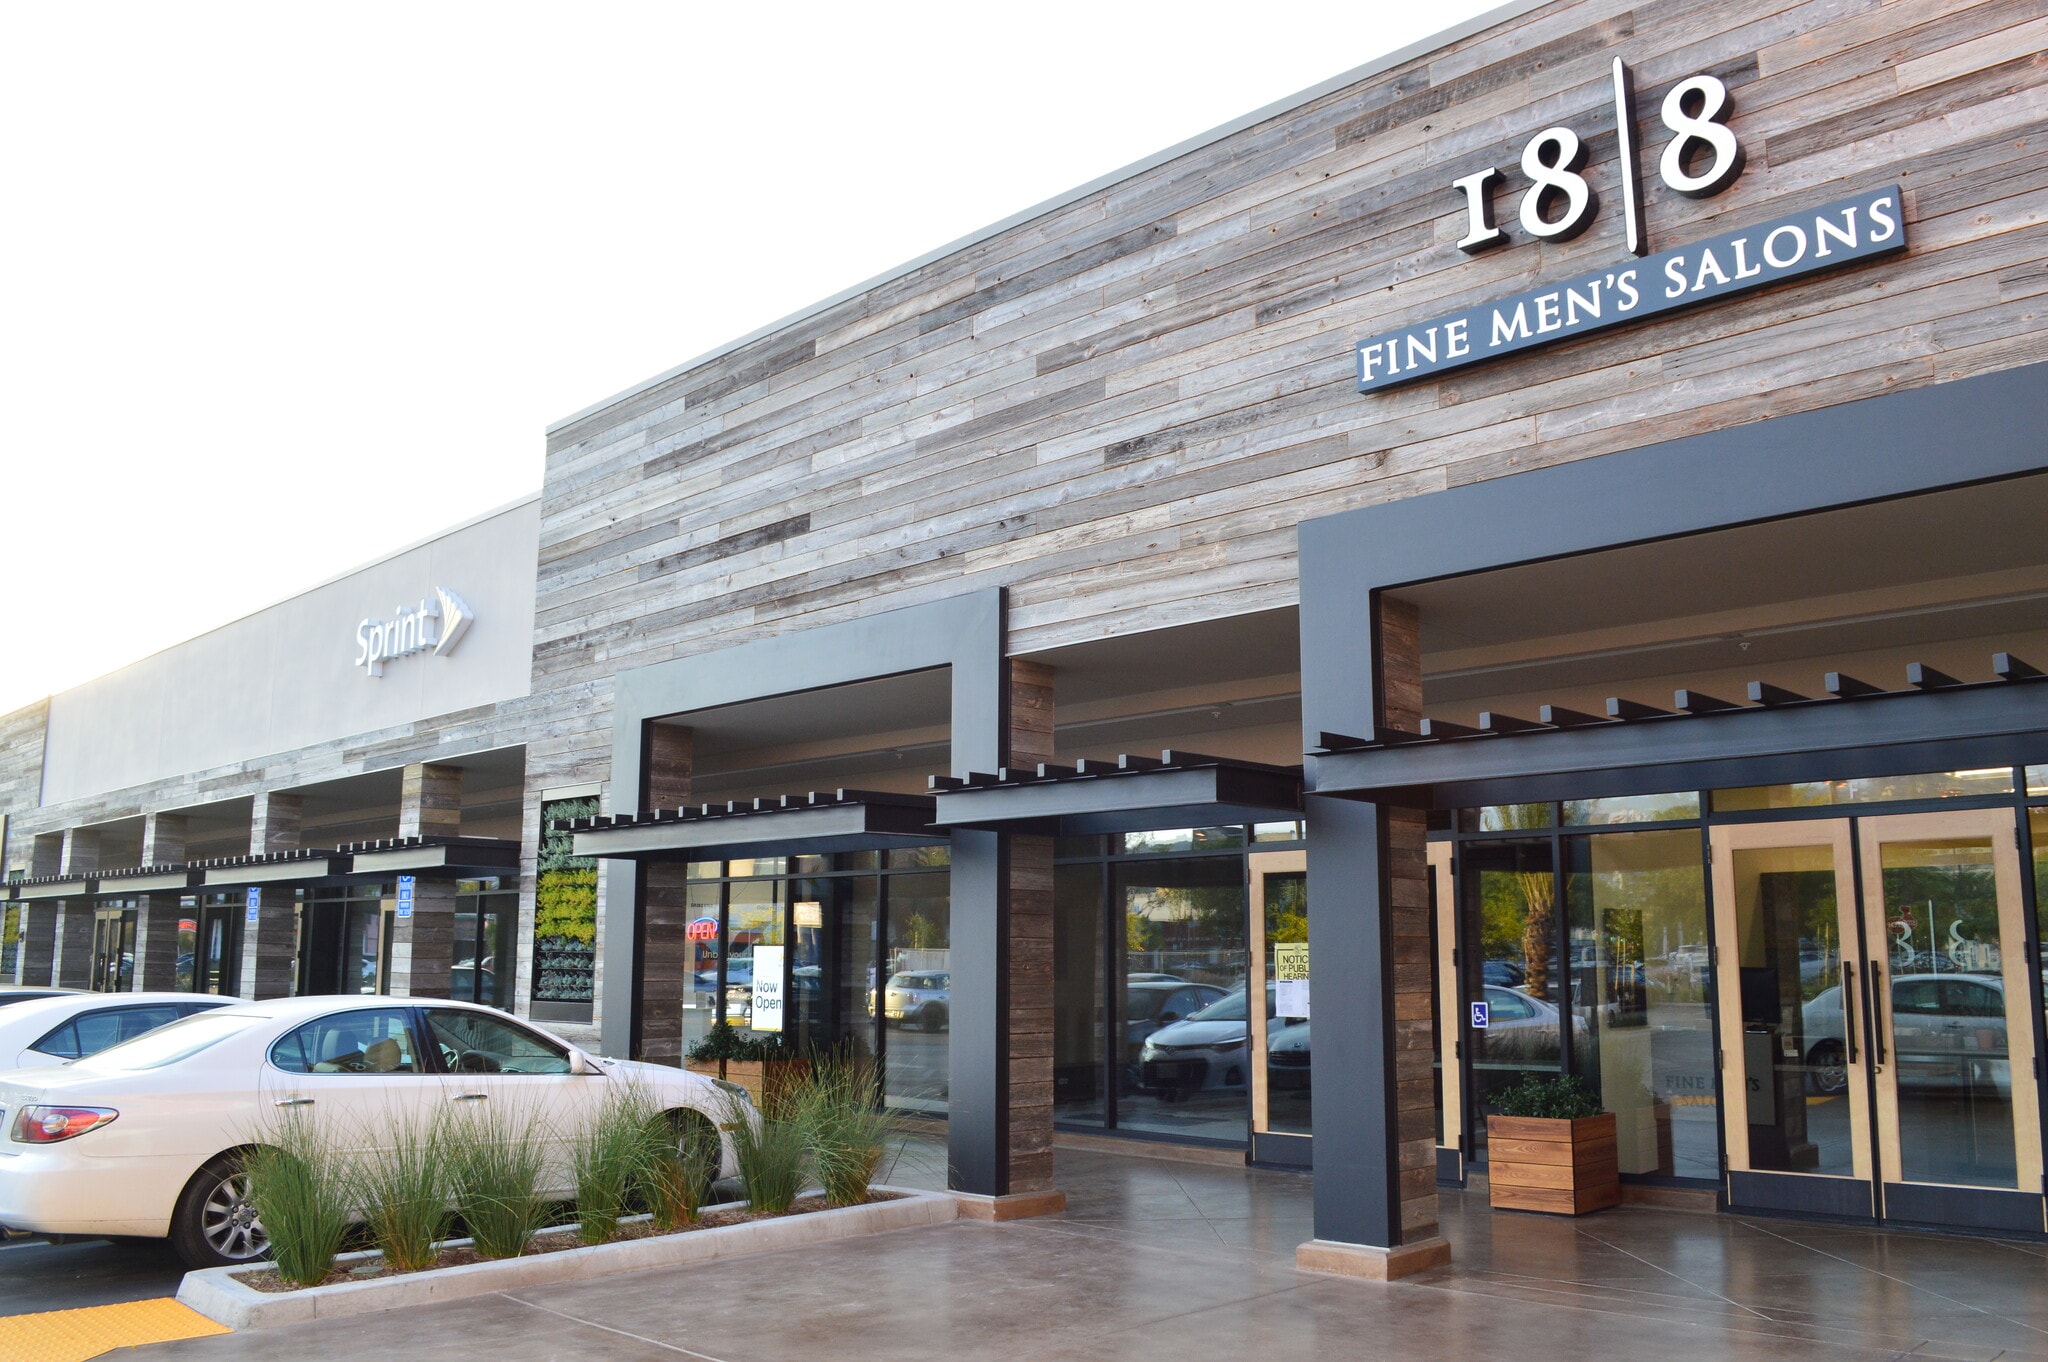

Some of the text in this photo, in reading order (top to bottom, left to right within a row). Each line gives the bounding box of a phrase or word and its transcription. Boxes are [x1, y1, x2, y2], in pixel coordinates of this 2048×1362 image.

[1360, 196, 1896, 382] FINE MEN'S SALONS
[355, 599, 434, 677] Sprint
[687, 922, 717, 940] OPEN
[702, 950, 719, 959] Unb
[1283, 955, 1309, 964] NOTIC
[1283, 972, 1310, 980] HEARIN
[1288, 964, 1310, 973] PUBL
[756, 979, 778, 993] Now
[755, 995, 782, 1012] Open
[1665, 1074, 1706, 1090] FINE
